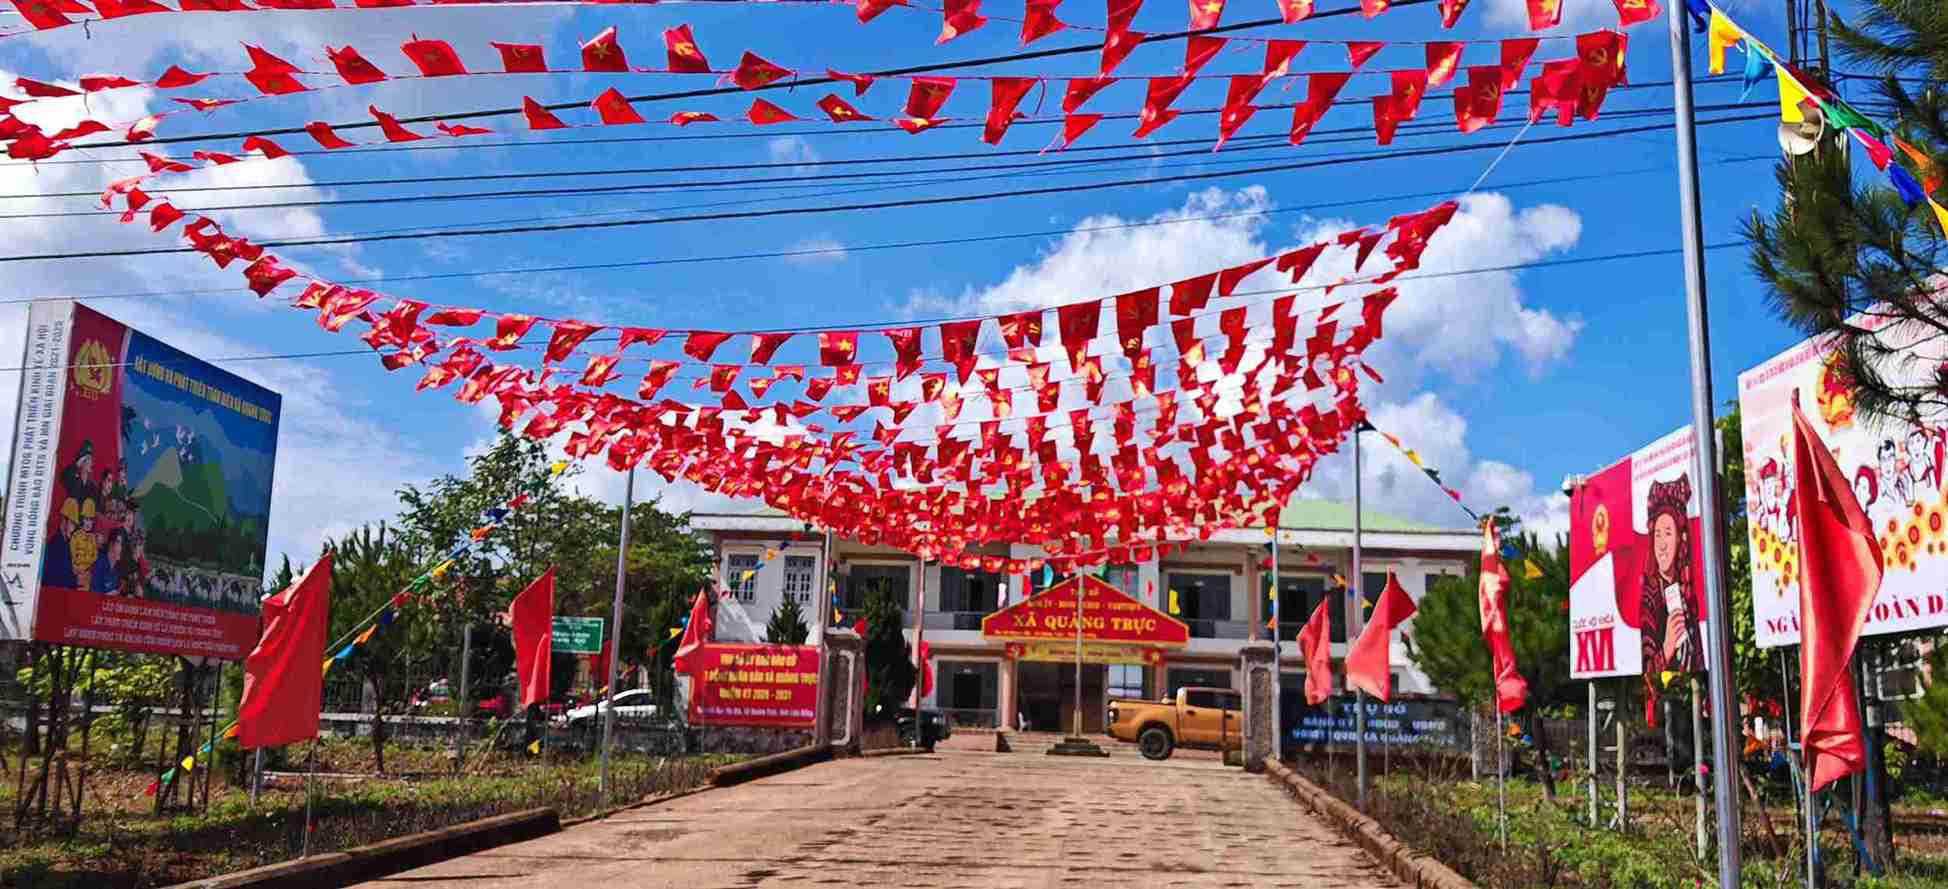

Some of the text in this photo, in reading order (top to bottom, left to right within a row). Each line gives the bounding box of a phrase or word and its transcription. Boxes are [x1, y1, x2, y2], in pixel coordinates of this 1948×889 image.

[22, 427, 35, 449] PHÁT
[30, 371, 41, 395] KINH
[1766, 609, 1800, 634] NGÀ
[1864, 594, 1920, 623] OÀN
[1044, 612, 1105, 630] QUẢNG
[1110, 617, 1157, 635] TRỰC
[1575, 629, 1616, 672] XVI
